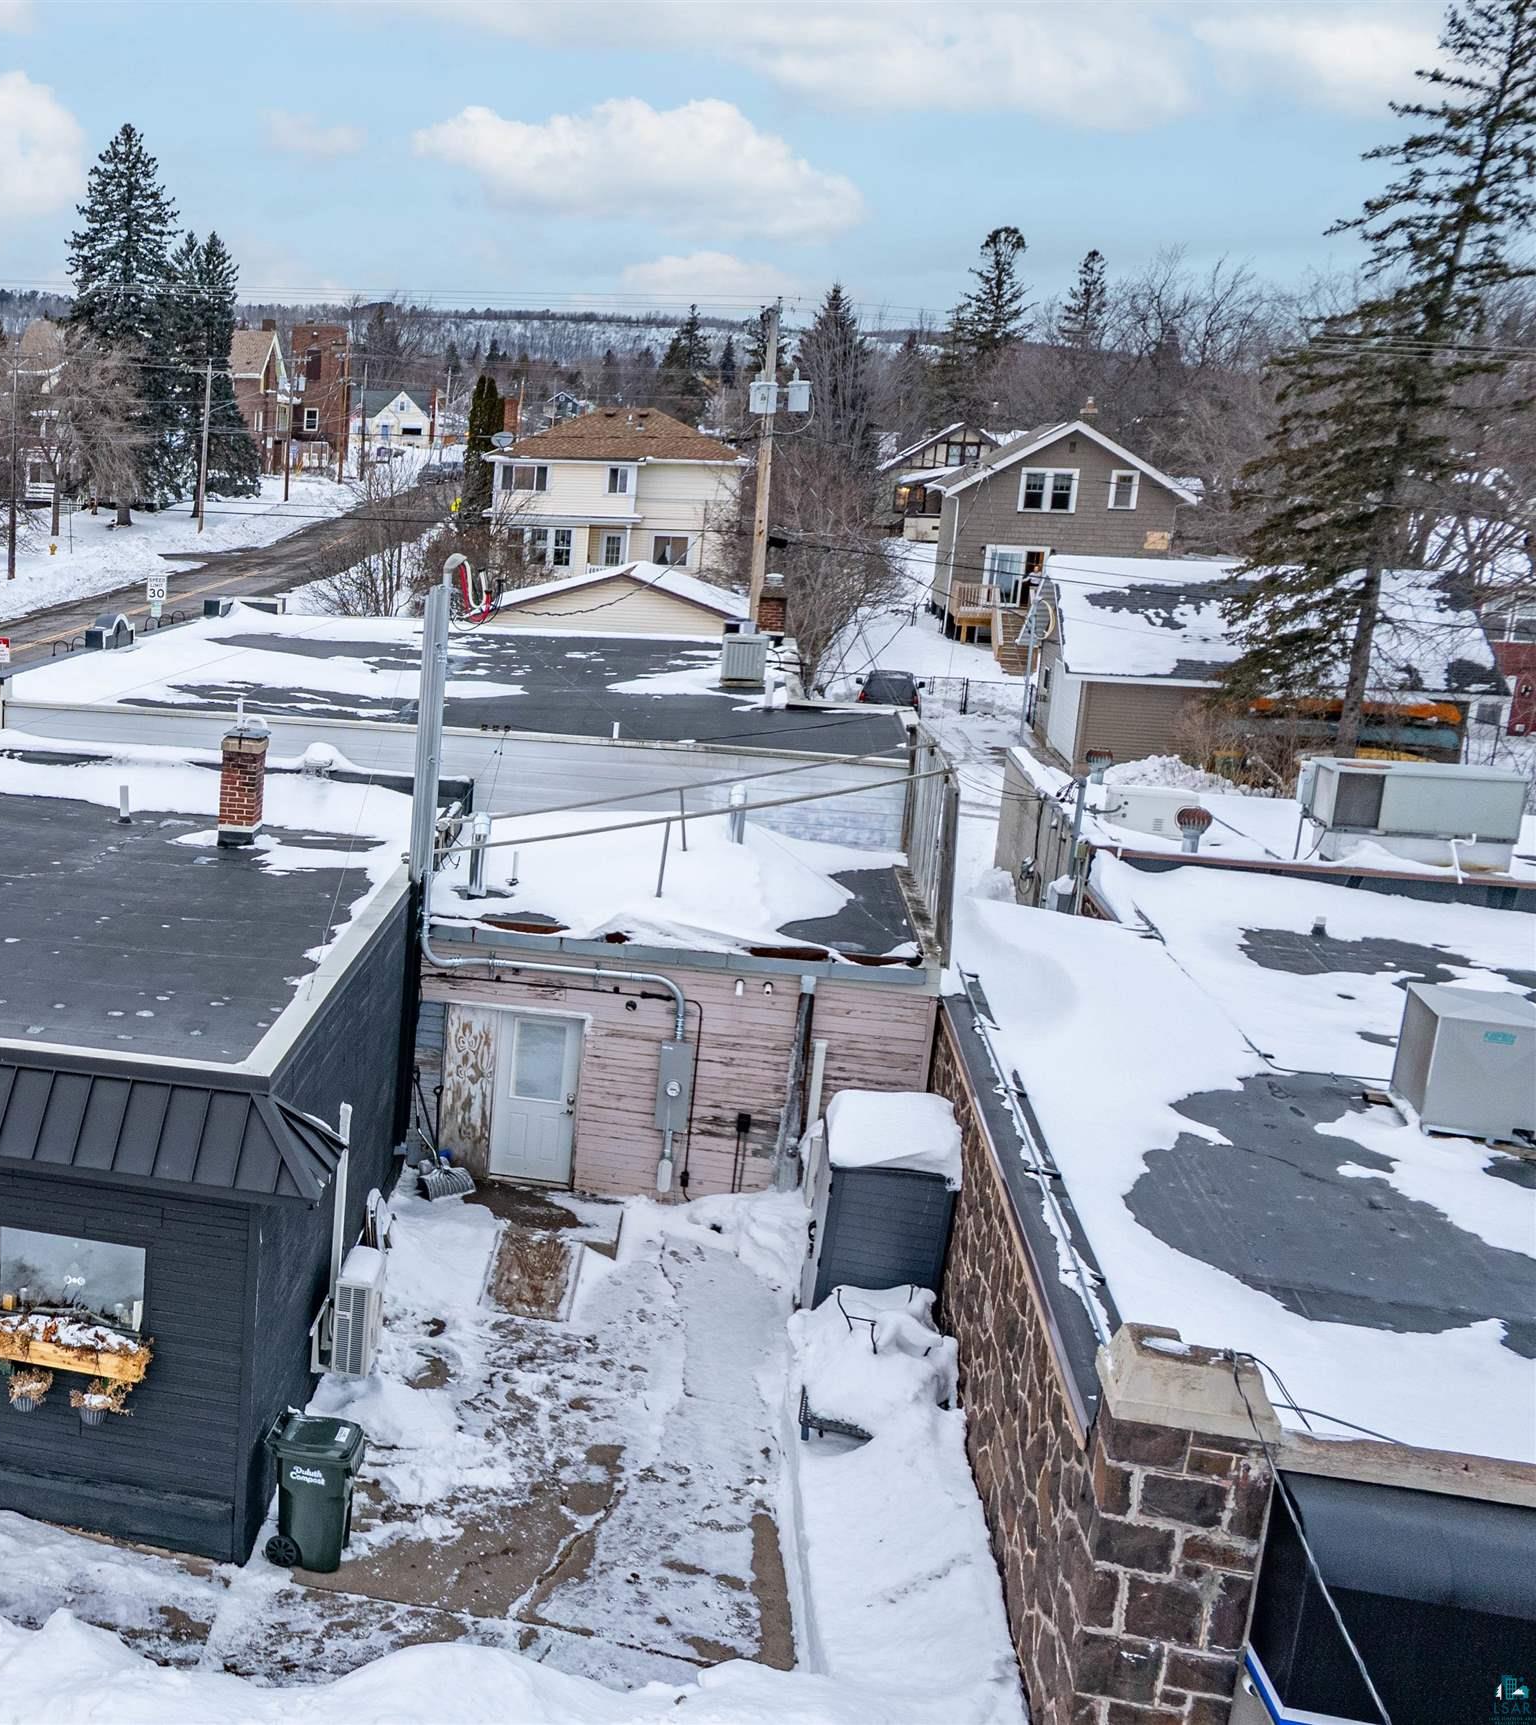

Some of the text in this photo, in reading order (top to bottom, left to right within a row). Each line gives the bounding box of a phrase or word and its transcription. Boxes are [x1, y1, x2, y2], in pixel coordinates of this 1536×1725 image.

[149, 588, 165, 599] 30
[293, 1465, 322, 1478] Duluth
[290, 1471, 326, 1486] Compost
